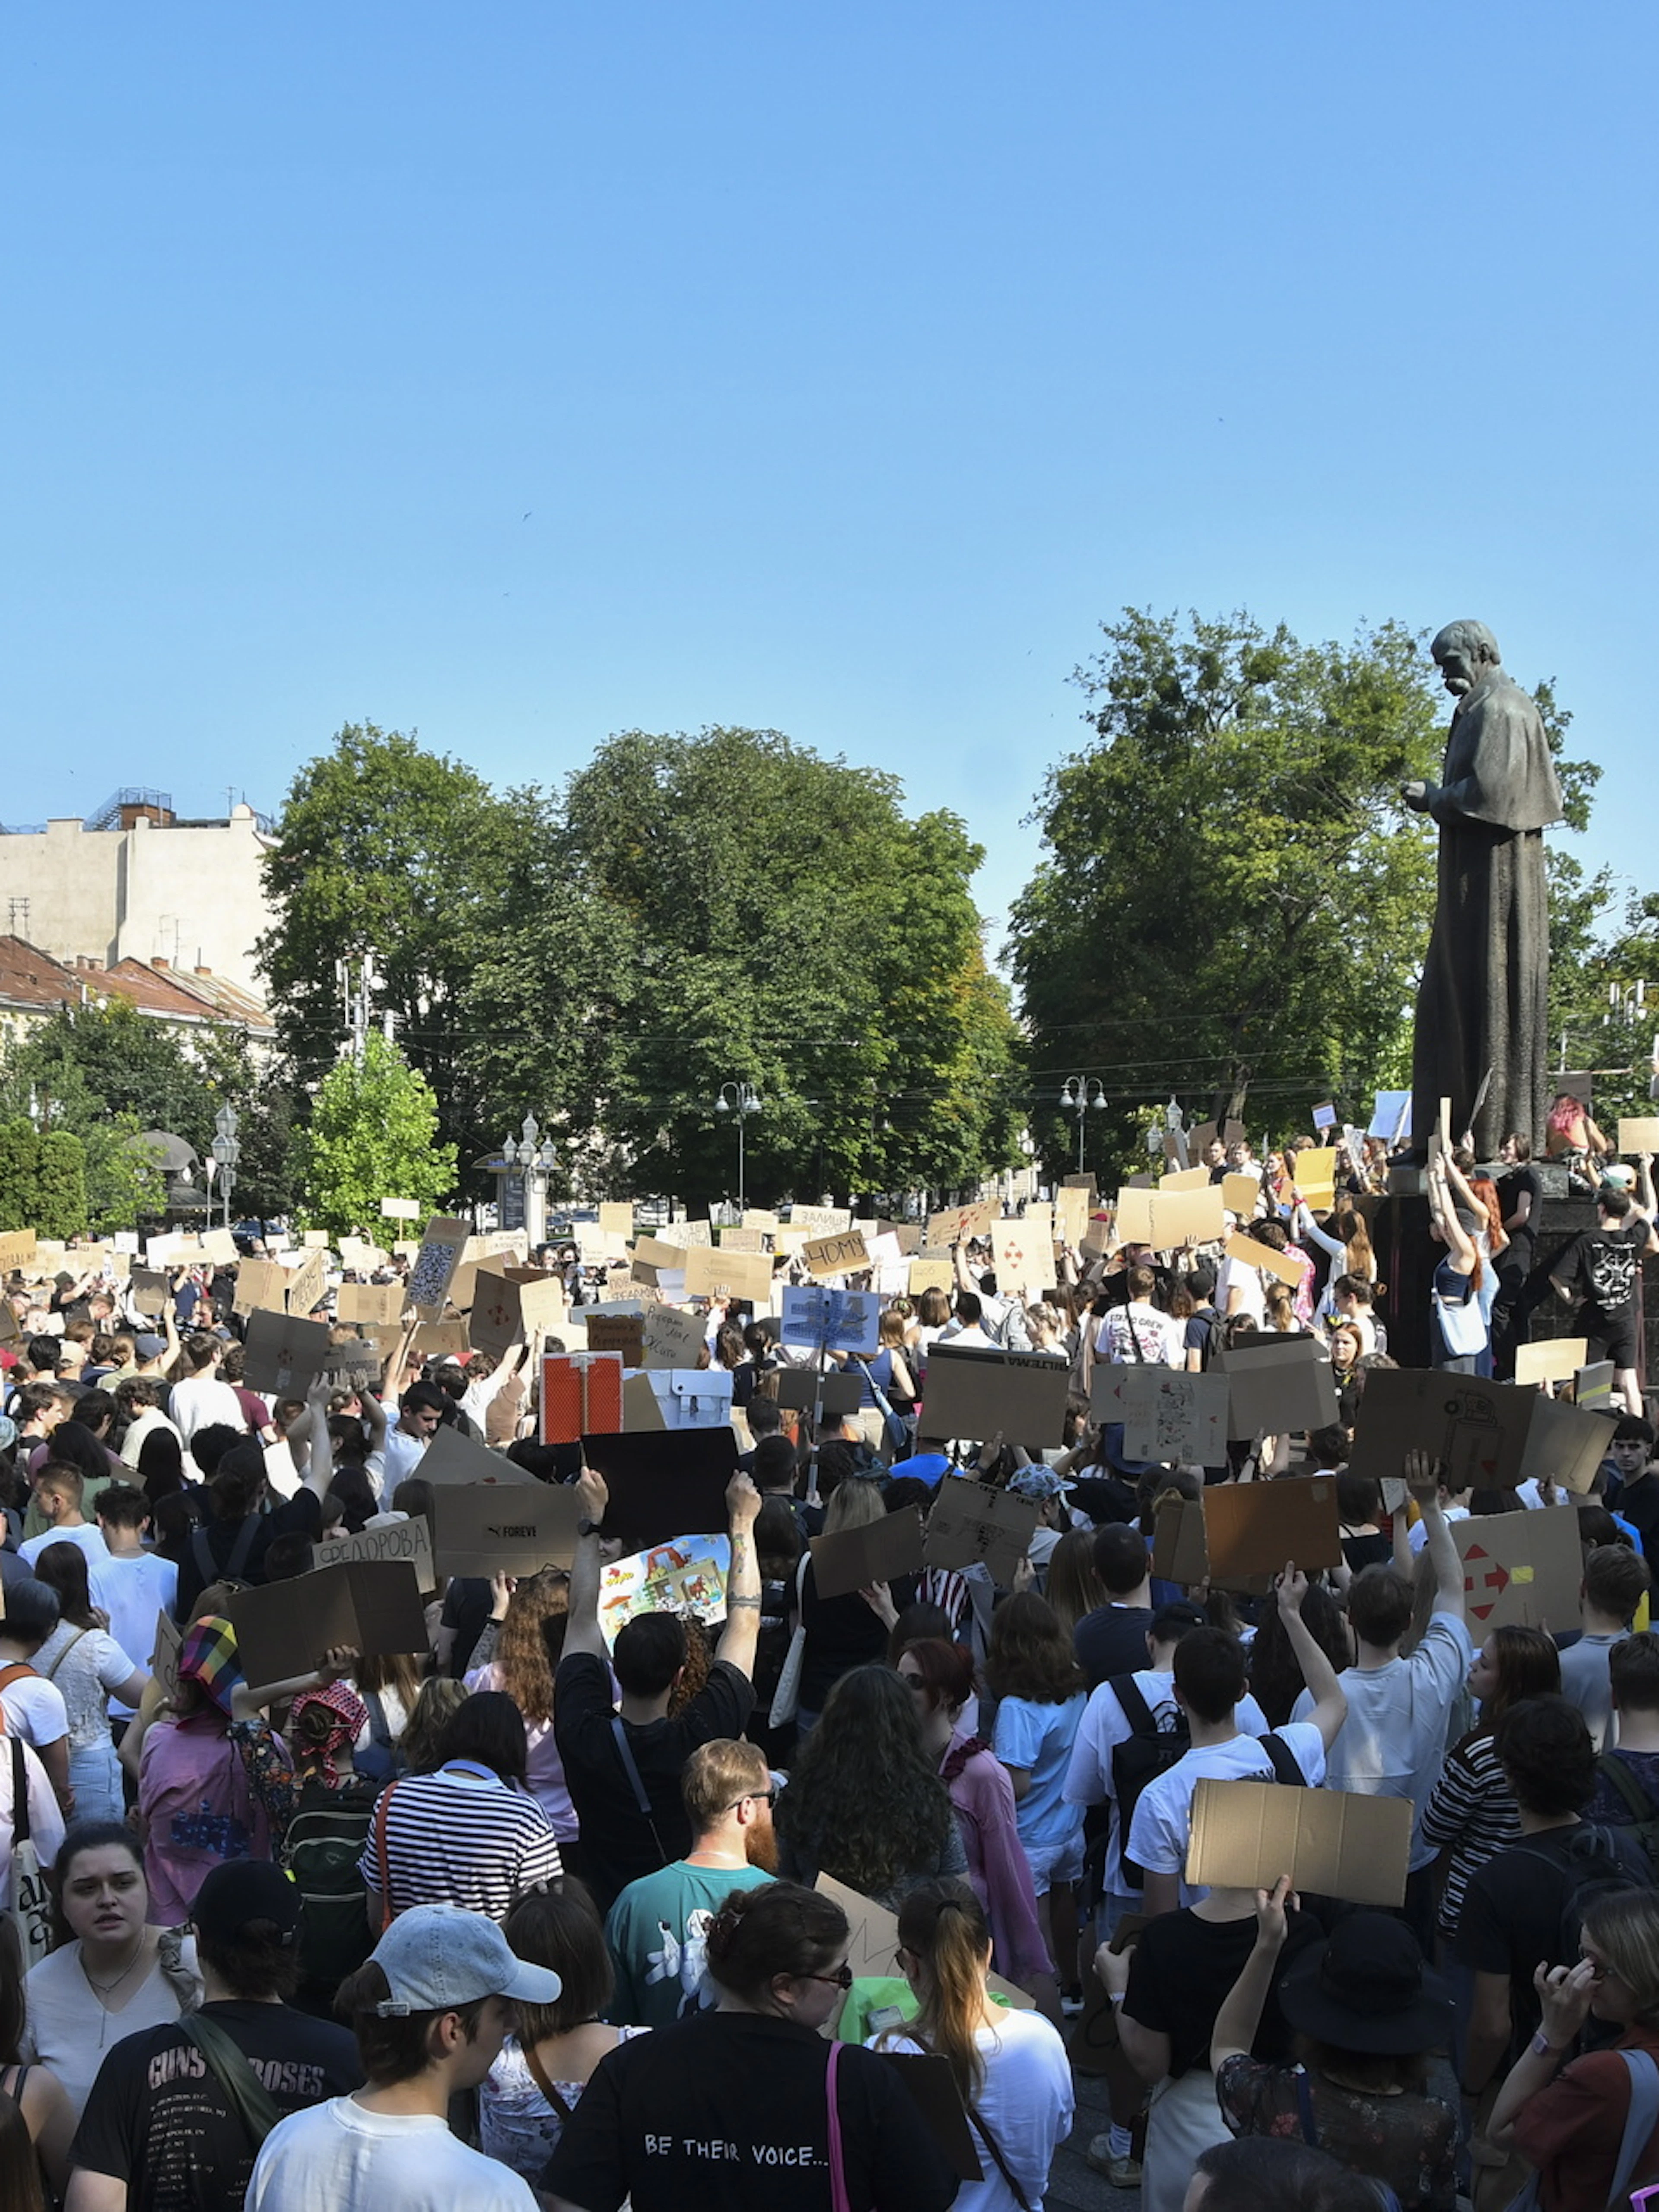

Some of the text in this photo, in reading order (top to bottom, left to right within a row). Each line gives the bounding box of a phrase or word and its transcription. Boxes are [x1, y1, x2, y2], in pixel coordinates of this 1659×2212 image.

[807, 1238, 864, 1266] ЧОМУ
[320, 1524, 428, 1563] ФЕДОРОВА
[148, 2045, 206, 2090] GUNS
[645, 2134, 829, 2166] BE THEIR VOICE...
